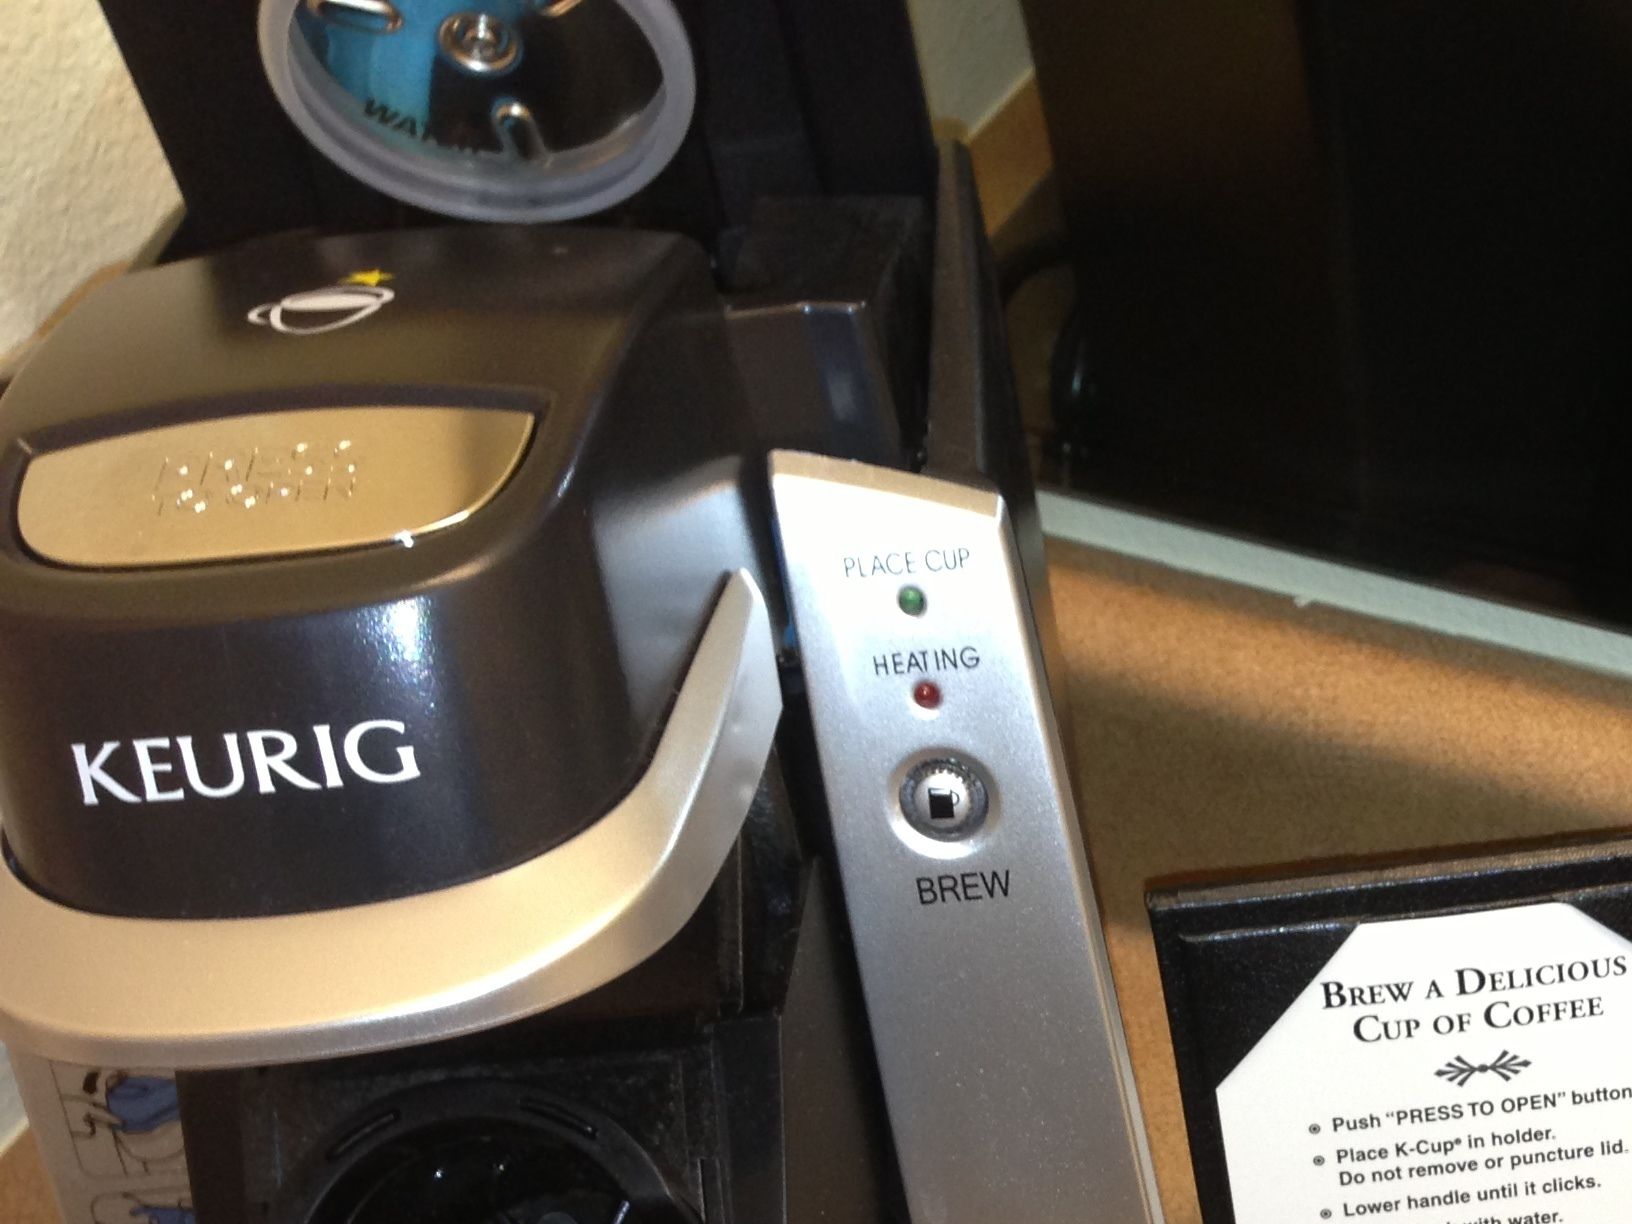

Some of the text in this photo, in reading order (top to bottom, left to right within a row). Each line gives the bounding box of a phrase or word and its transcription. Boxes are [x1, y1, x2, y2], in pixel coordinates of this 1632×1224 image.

[843, 547, 970, 578] PLACE CUP
[873, 646, 980, 676] HEATING
[71, 720, 421, 806] KEURIG
[916, 870, 1010, 905] BREW
[1320, 955, 1627, 1009] BREW A DELICIOUS
[1353, 997, 1604, 1042] CUP OF COFFEE
[1332, 1114, 1381, 1132] Push
[1386, 1104, 1464, 1125] “PRESS
[1468, 1100, 1494, 1117] TO
[1501, 1092, 1566, 1113] OPEN”
[1336, 1147, 1388, 1164] Place
[1468, 1134, 1485, 1149] in
[1492, 1127, 1556, 1146] holder.
[1339, 1139, 1629, 1186] Do not remove or puncture lid.
[1343, 1175, 1602, 1217] Lower handle until it clicks.
